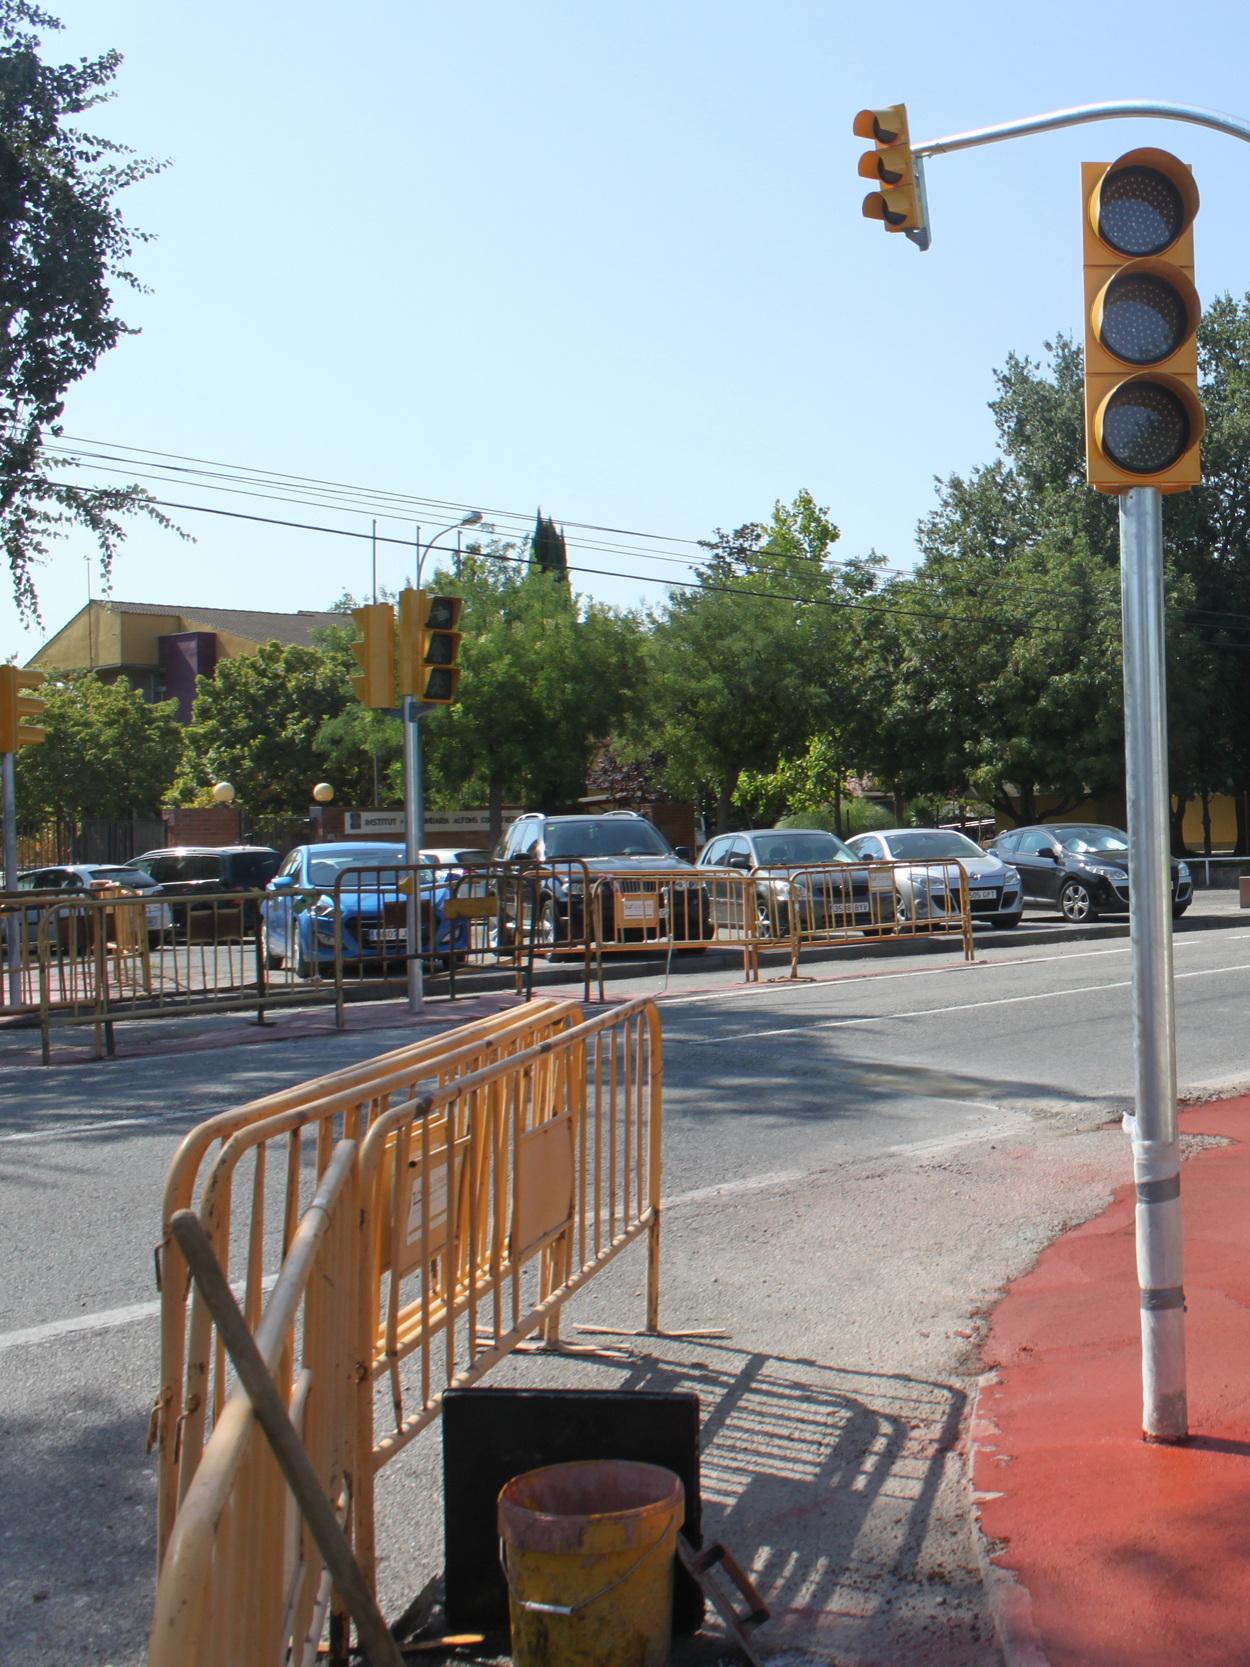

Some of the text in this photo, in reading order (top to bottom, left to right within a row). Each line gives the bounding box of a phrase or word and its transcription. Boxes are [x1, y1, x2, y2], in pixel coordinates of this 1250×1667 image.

[365, 818, 397, 826] INSTITUT
[453, 816, 478, 824] ALFONS
[969, 891, 981, 899] 505
[833, 905, 852, 913] 358
